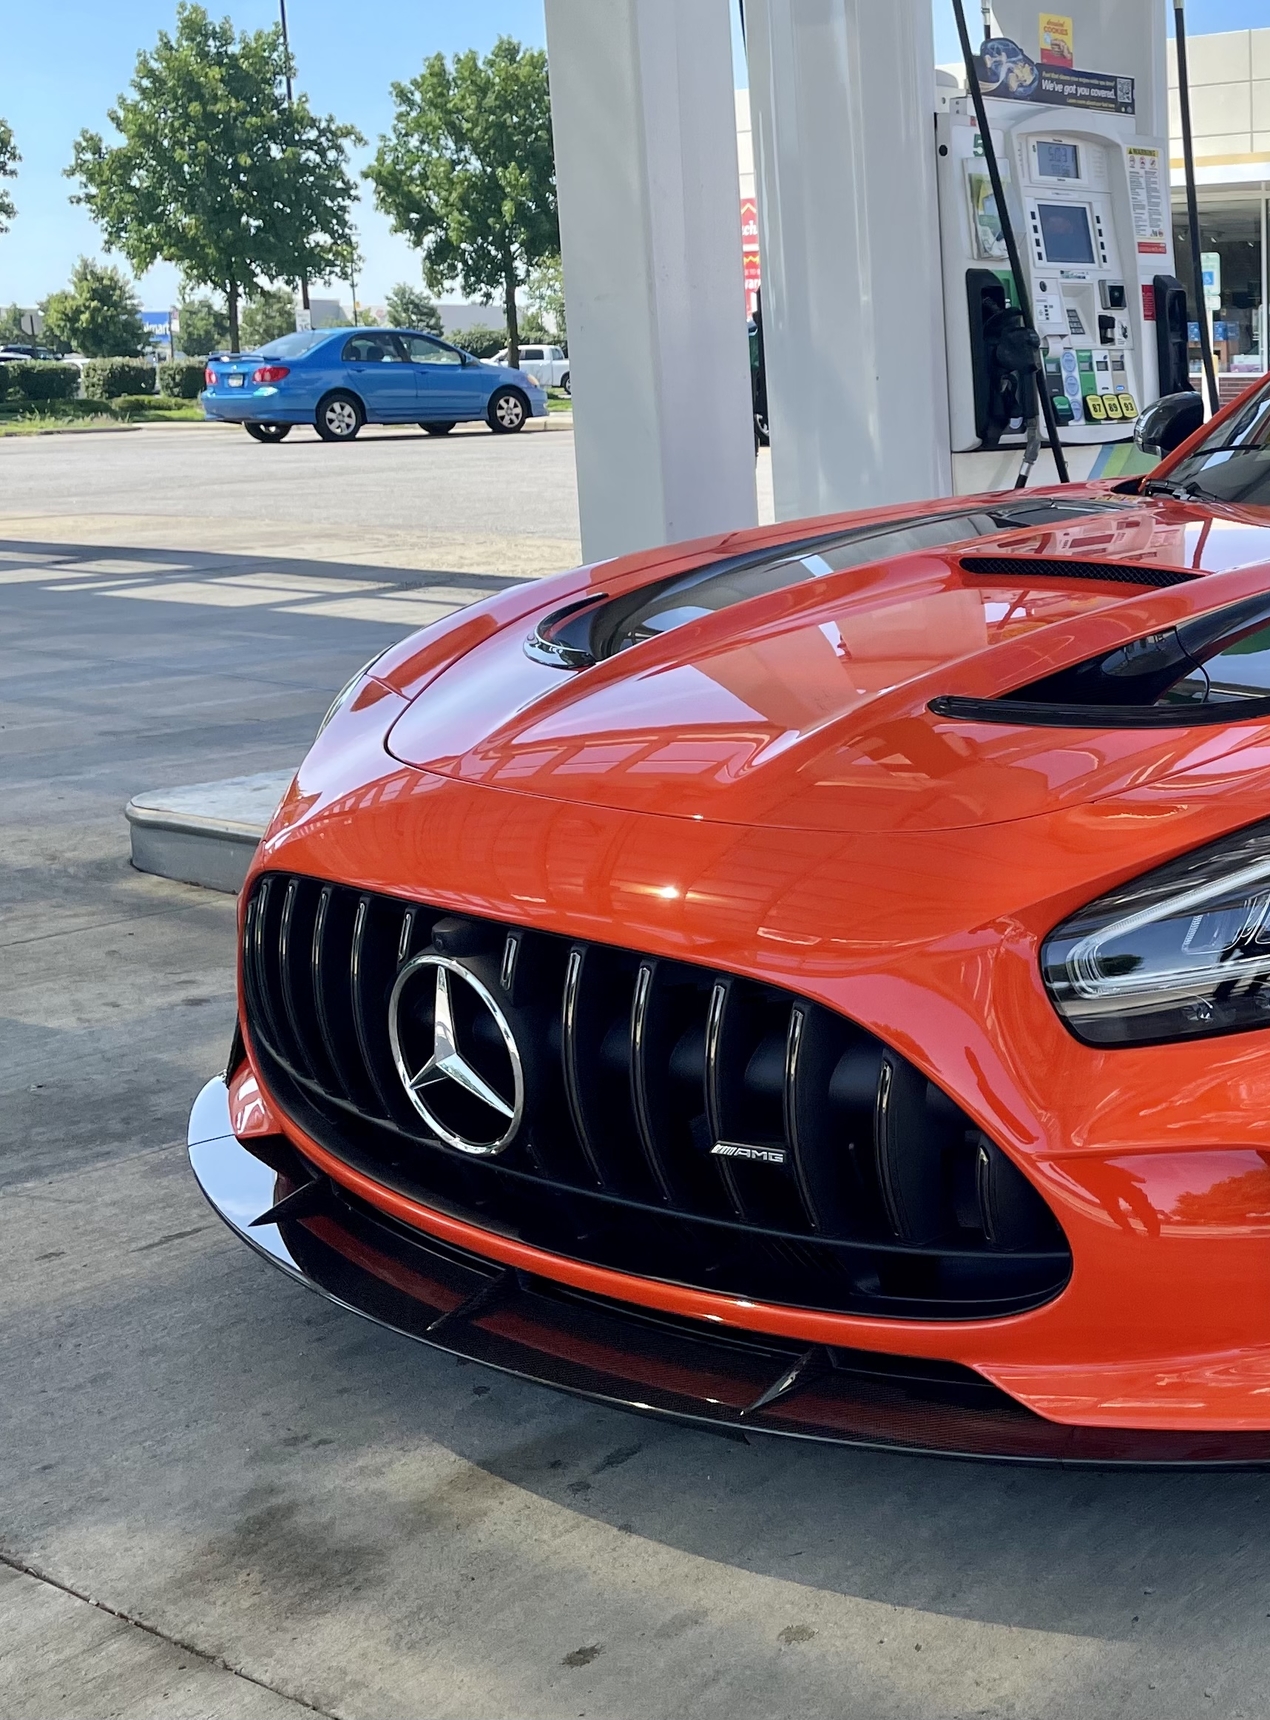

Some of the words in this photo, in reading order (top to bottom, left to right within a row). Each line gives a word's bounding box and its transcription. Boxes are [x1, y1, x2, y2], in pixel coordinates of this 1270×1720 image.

[1041, 79, 1064, 92] We've
[1064, 83, 1077, 95] got
[1077, 86, 1090, 96] you
[1090, 87, 1116, 99] covered.
[973, 133, 986, 157] 5
[1092, 404, 1102, 413] 87
[1108, 402, 1119, 413] 89
[1123, 402, 1134, 411] 93
[733, 1147, 784, 1163] AMG
